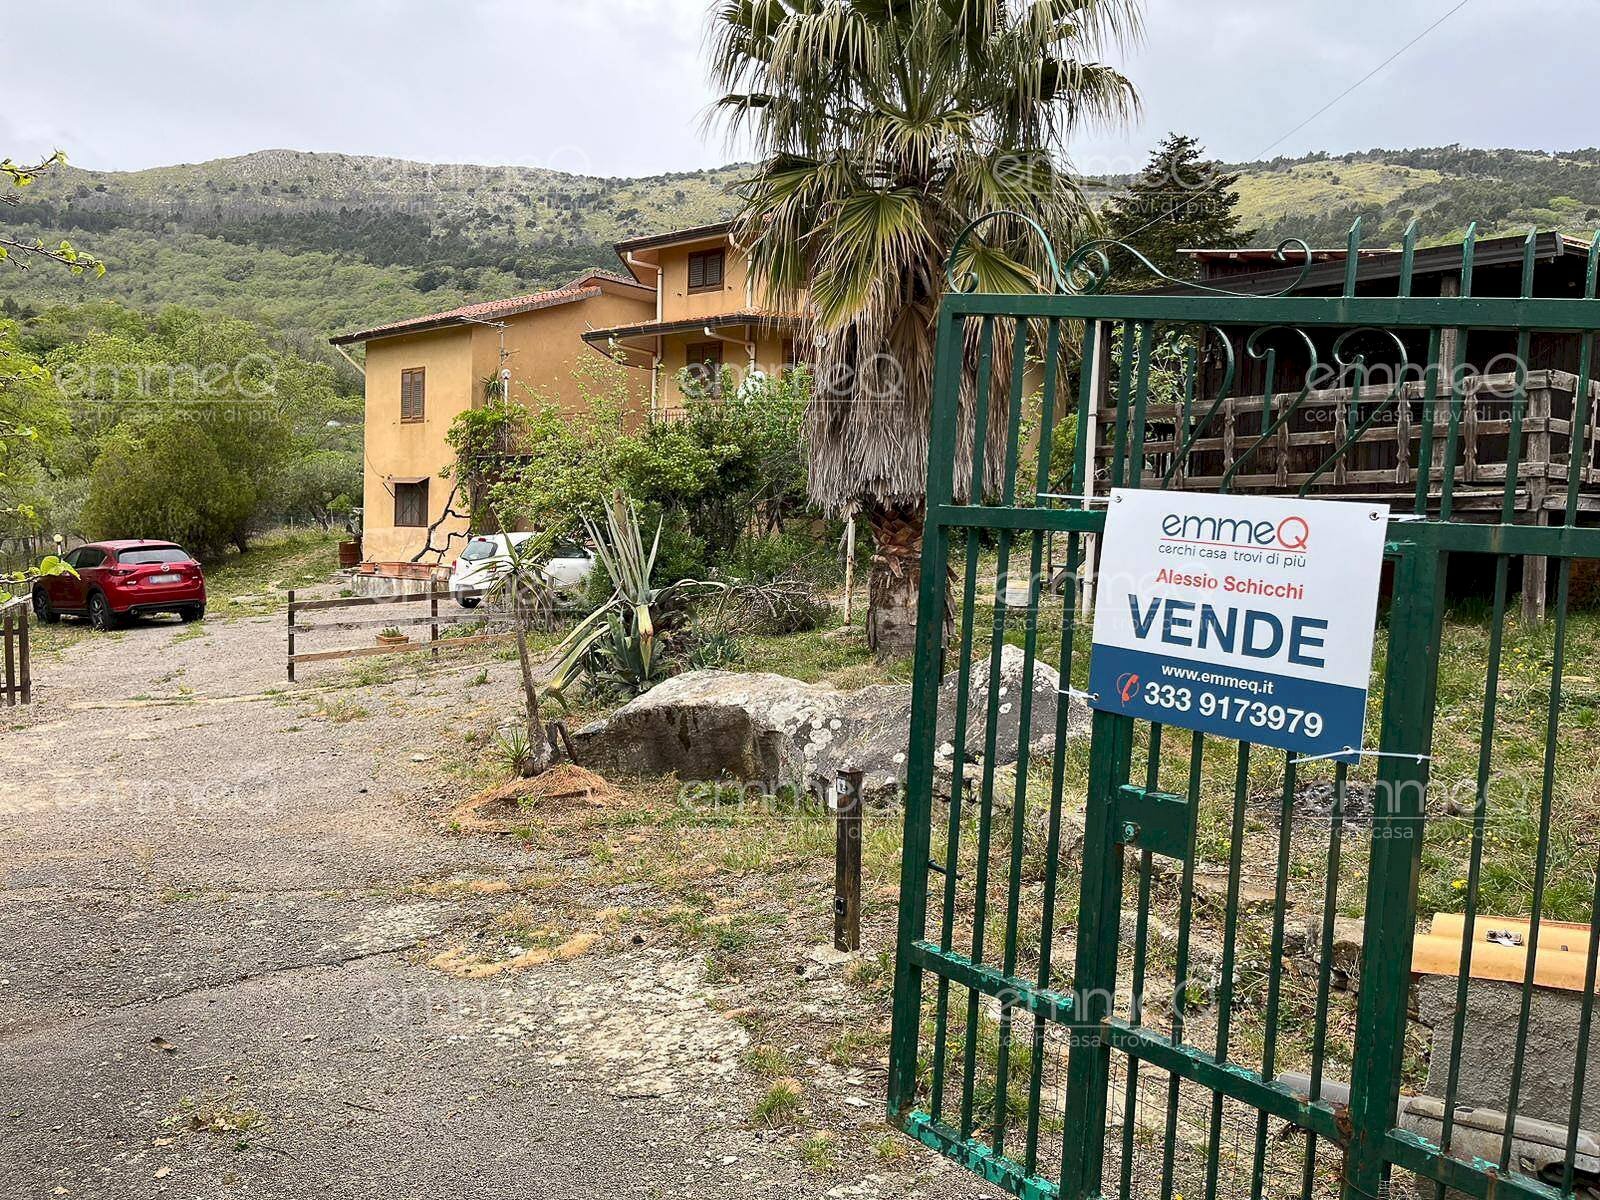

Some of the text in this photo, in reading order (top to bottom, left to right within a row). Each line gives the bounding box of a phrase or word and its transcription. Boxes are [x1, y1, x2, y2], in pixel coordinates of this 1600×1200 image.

[1161, 513, 1310, 550] emmeQ
[1158, 543, 1307, 569] cerchi casa trovi di più
[1155, 568, 1304, 600] Alessio Schicchi
[1127, 593, 1329, 669] VENDE
[1161, 664, 1275, 695] www.emmeq.it
[1144, 681, 1324, 738] 333 9173979
